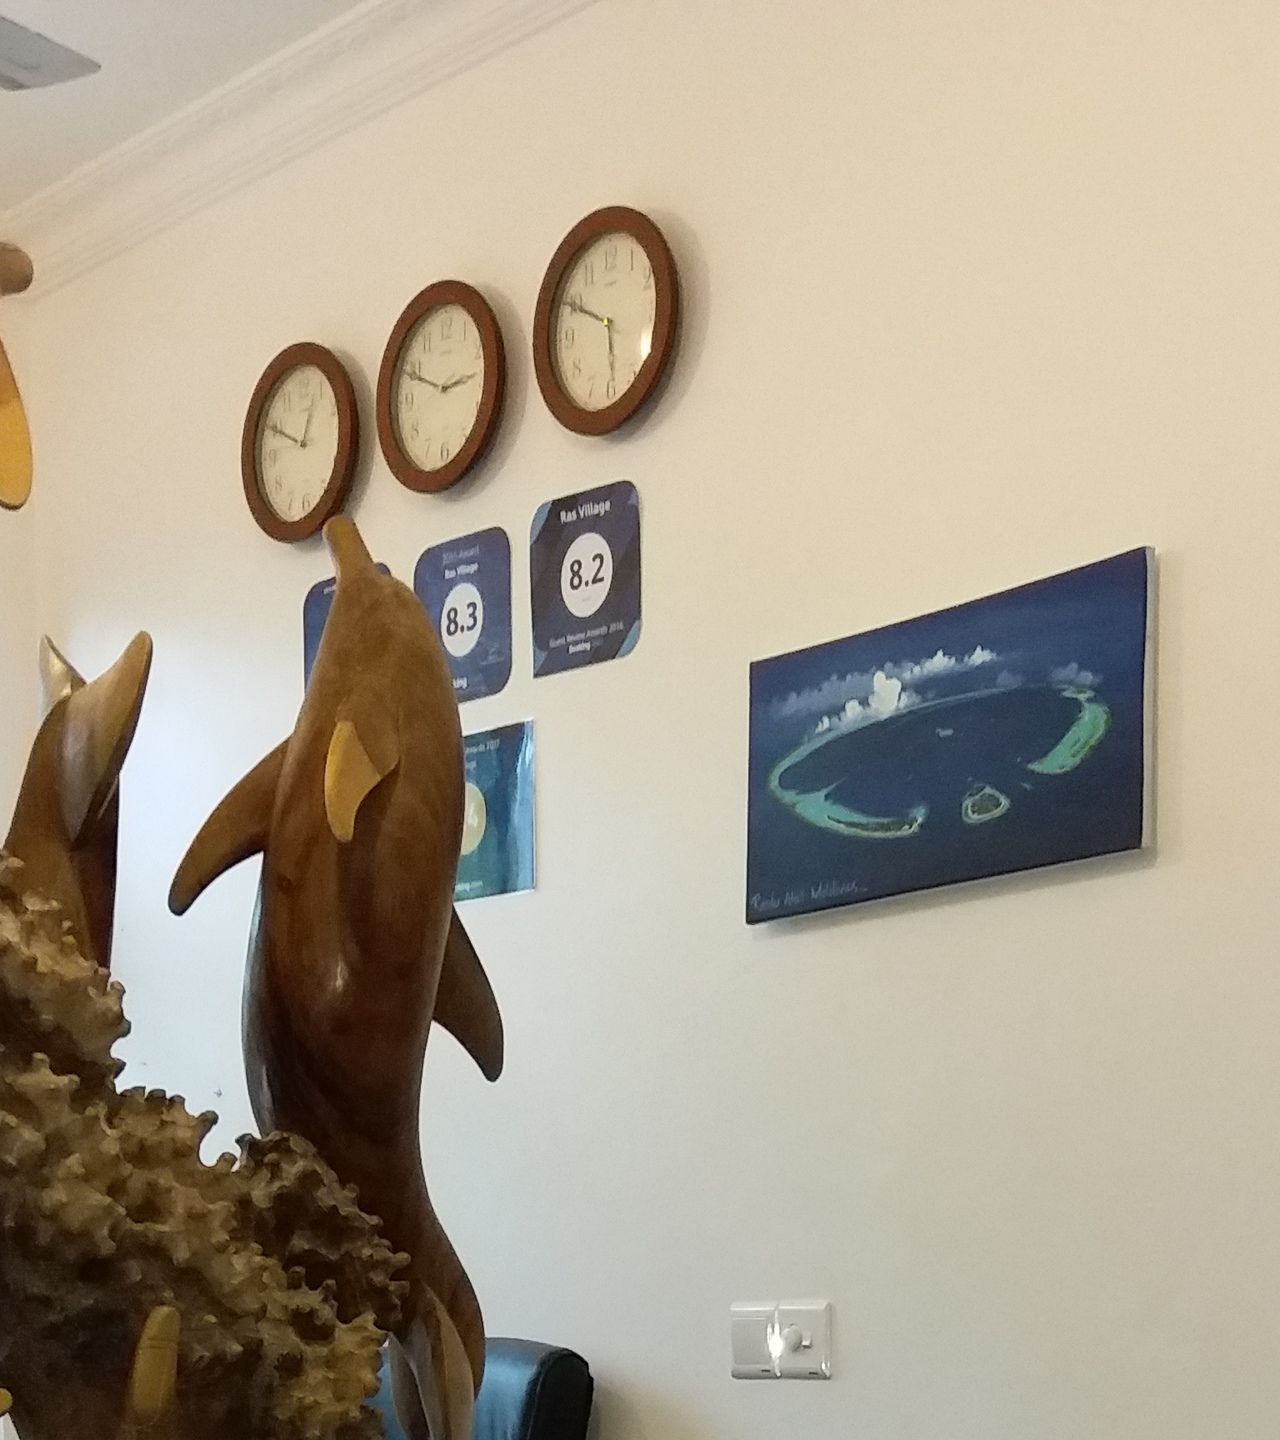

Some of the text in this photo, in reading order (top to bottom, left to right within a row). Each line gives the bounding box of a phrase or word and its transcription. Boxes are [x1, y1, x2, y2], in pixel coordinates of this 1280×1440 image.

[560, 499, 612, 524] Ras Village
[569, 553, 605, 591] 8.2
[446, 601, 478, 637] 8.3
